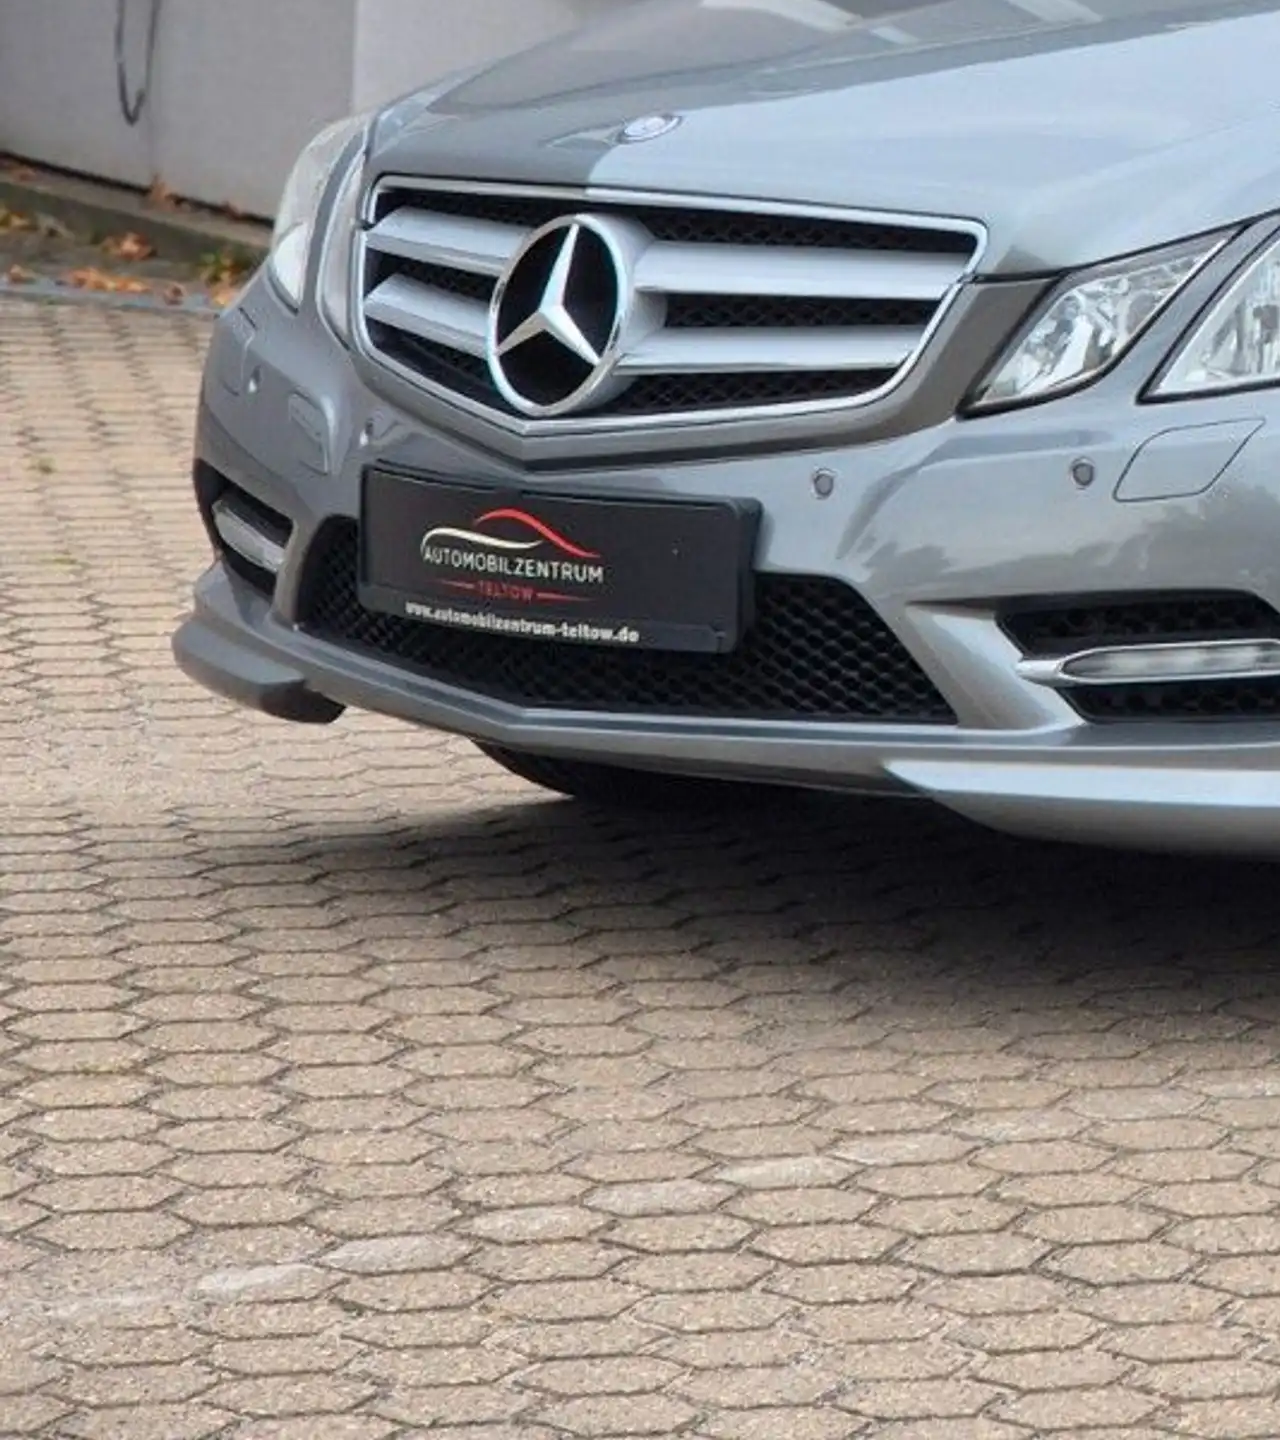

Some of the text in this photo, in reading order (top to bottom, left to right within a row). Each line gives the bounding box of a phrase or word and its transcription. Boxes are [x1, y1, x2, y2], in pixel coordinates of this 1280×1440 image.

[423, 545, 604, 584] AUTOMOBILZENTRUM
[477, 579, 534, 601] TELTOW
[405, 600, 641, 643] www.automobilzentrum-teltow.de
